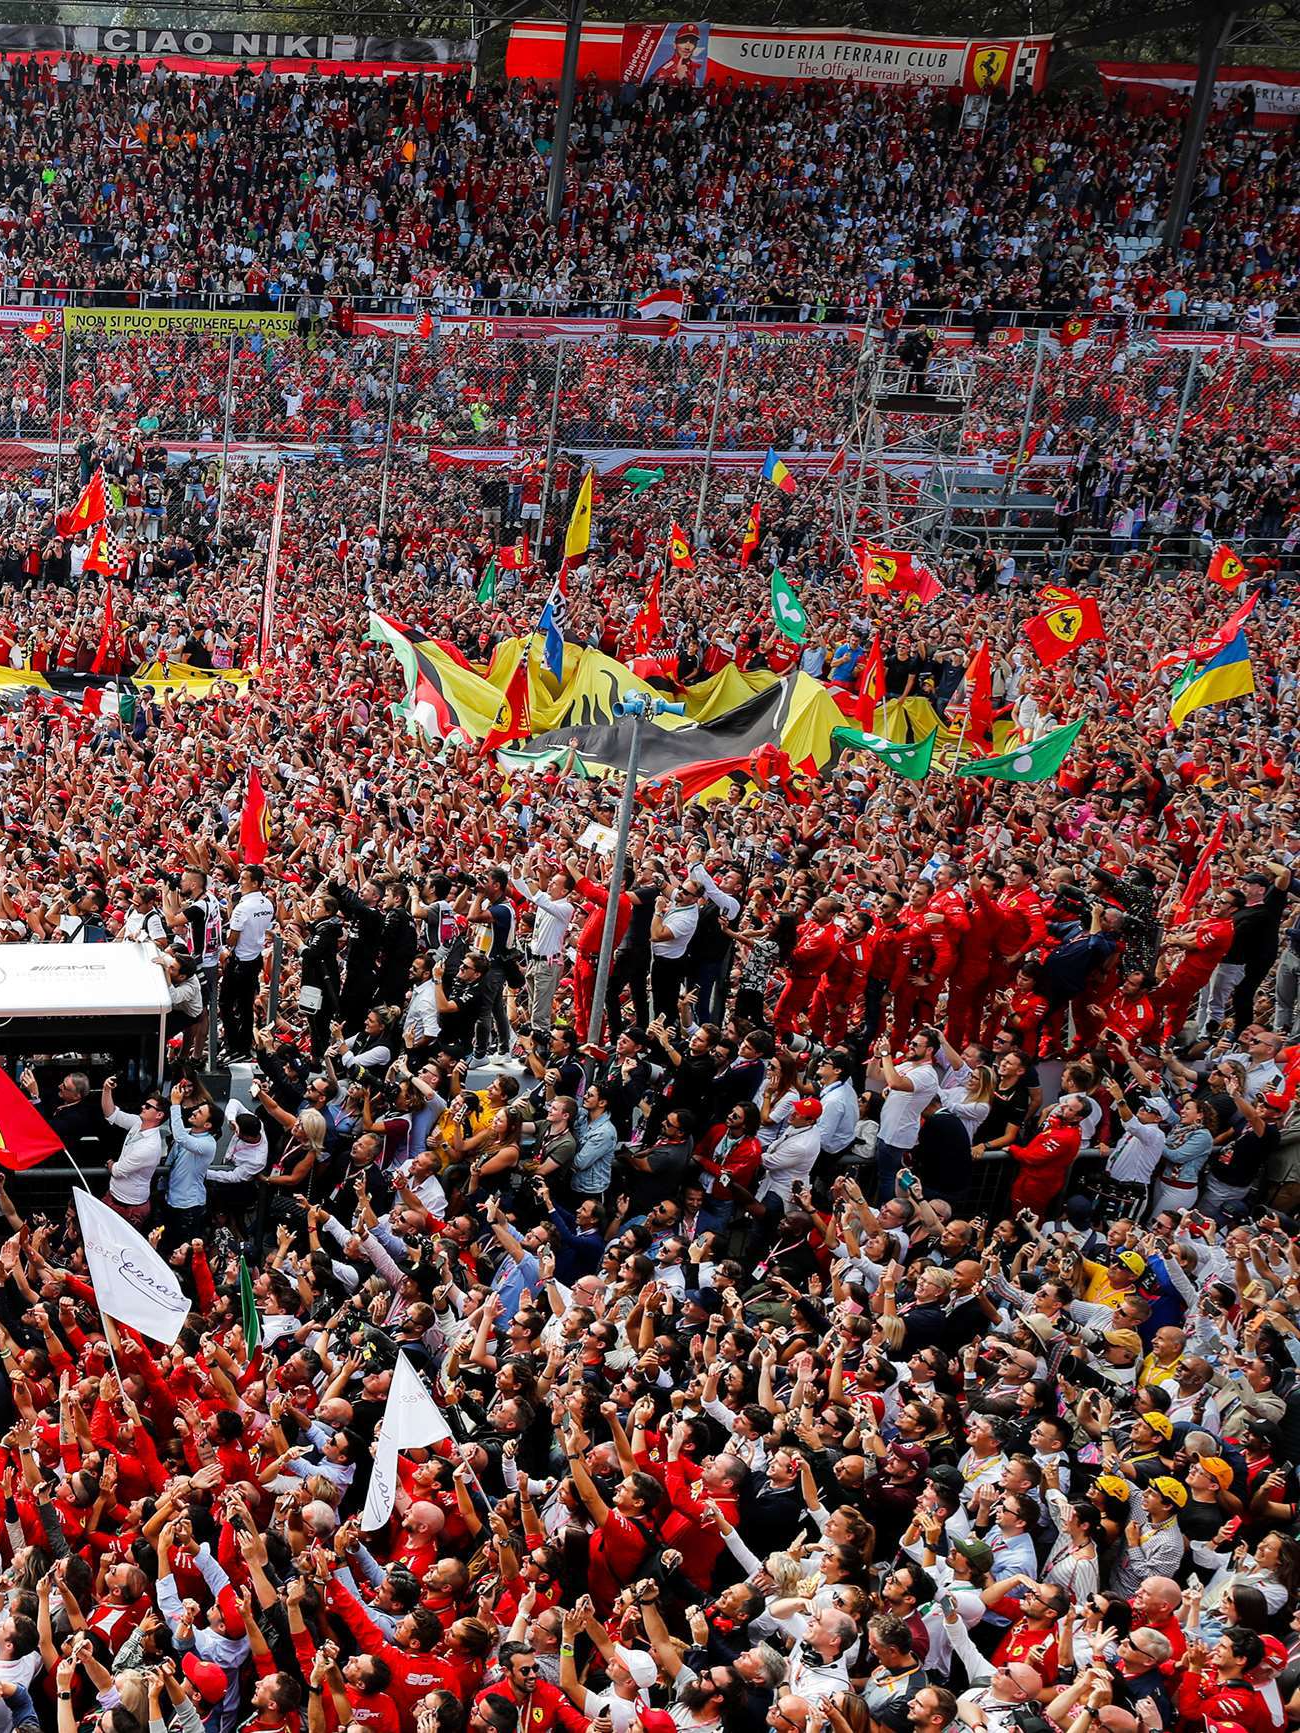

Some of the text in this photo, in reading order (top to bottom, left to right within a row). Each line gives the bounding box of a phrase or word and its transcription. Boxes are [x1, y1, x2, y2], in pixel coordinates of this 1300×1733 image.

[103, 28, 328, 58] CIAO NIKI
[739, 42, 949, 68] SCUDERIA FERRARI CLUB
[797, 62, 946, 83] The Official Ferrari Passion
[110, 315, 121, 327] SI
